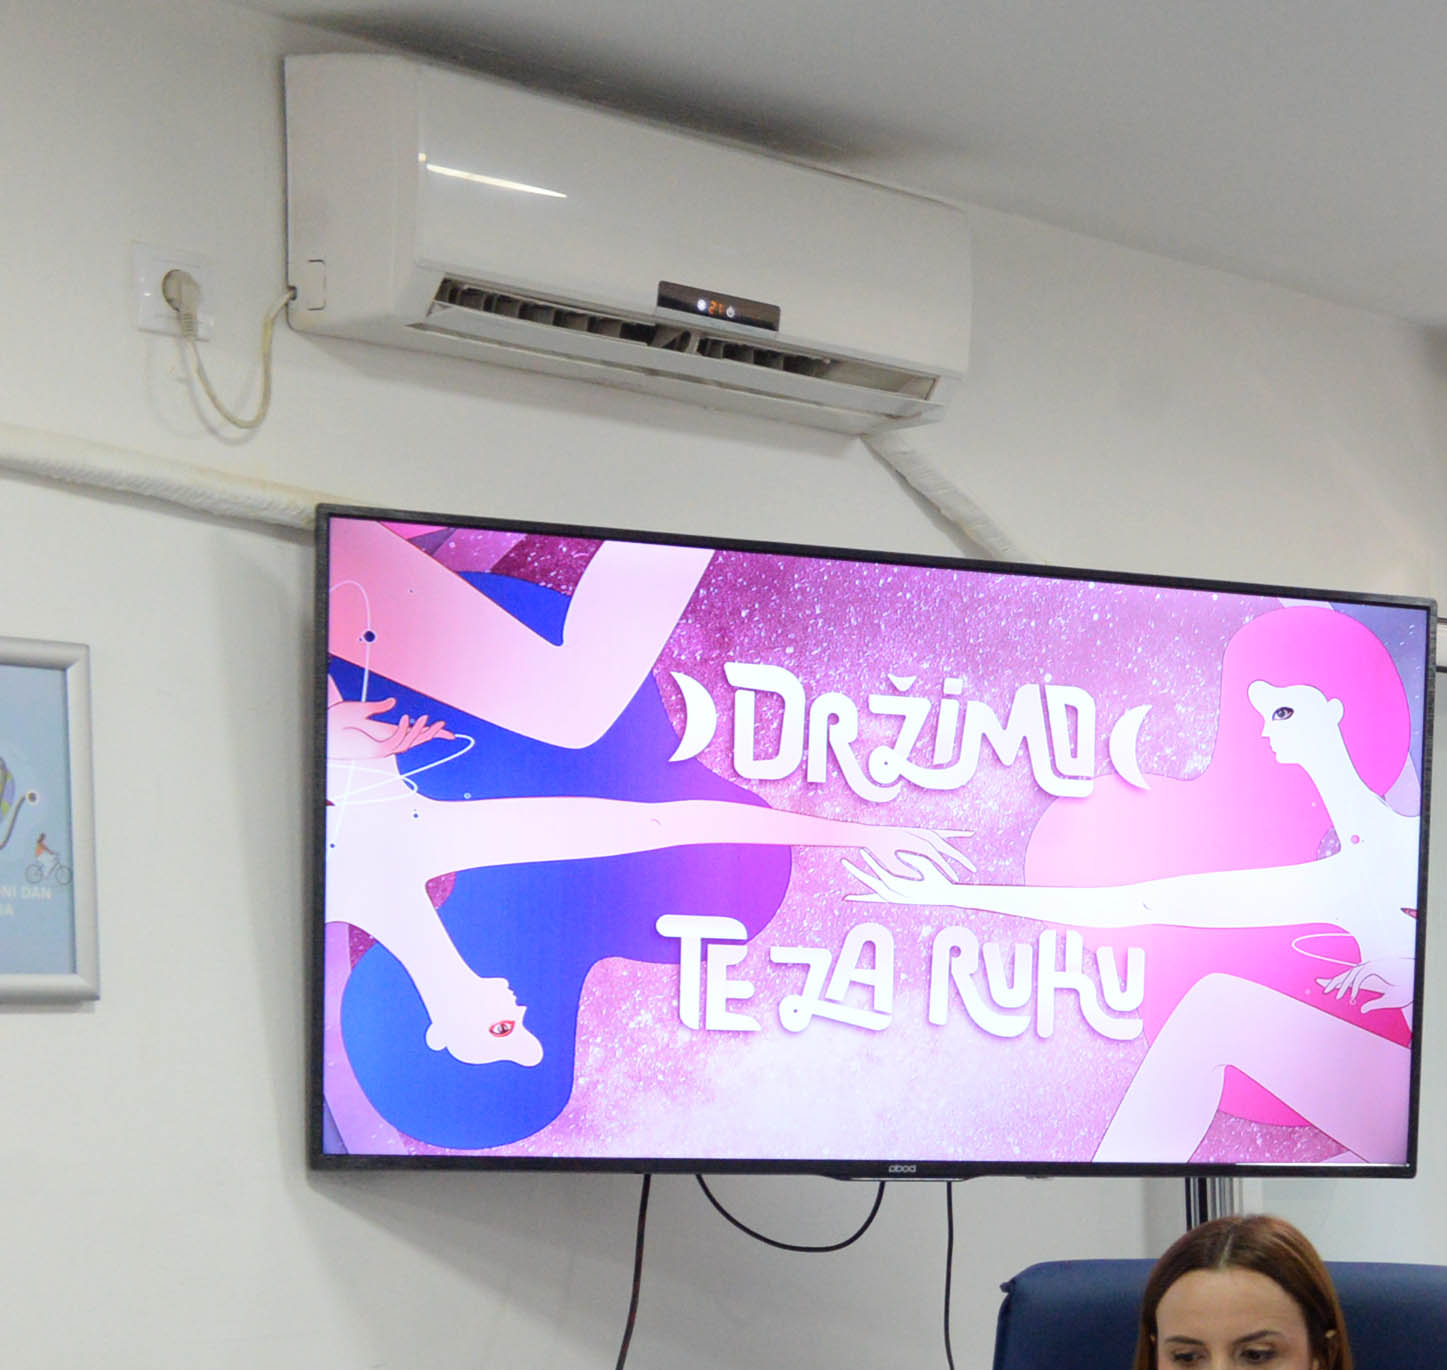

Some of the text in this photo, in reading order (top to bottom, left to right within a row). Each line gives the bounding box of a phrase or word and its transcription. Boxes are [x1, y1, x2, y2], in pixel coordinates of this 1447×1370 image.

[723, 661, 1096, 803] DRŽIMO
[655, 913, 1146, 1041] TE ZA RUKU
